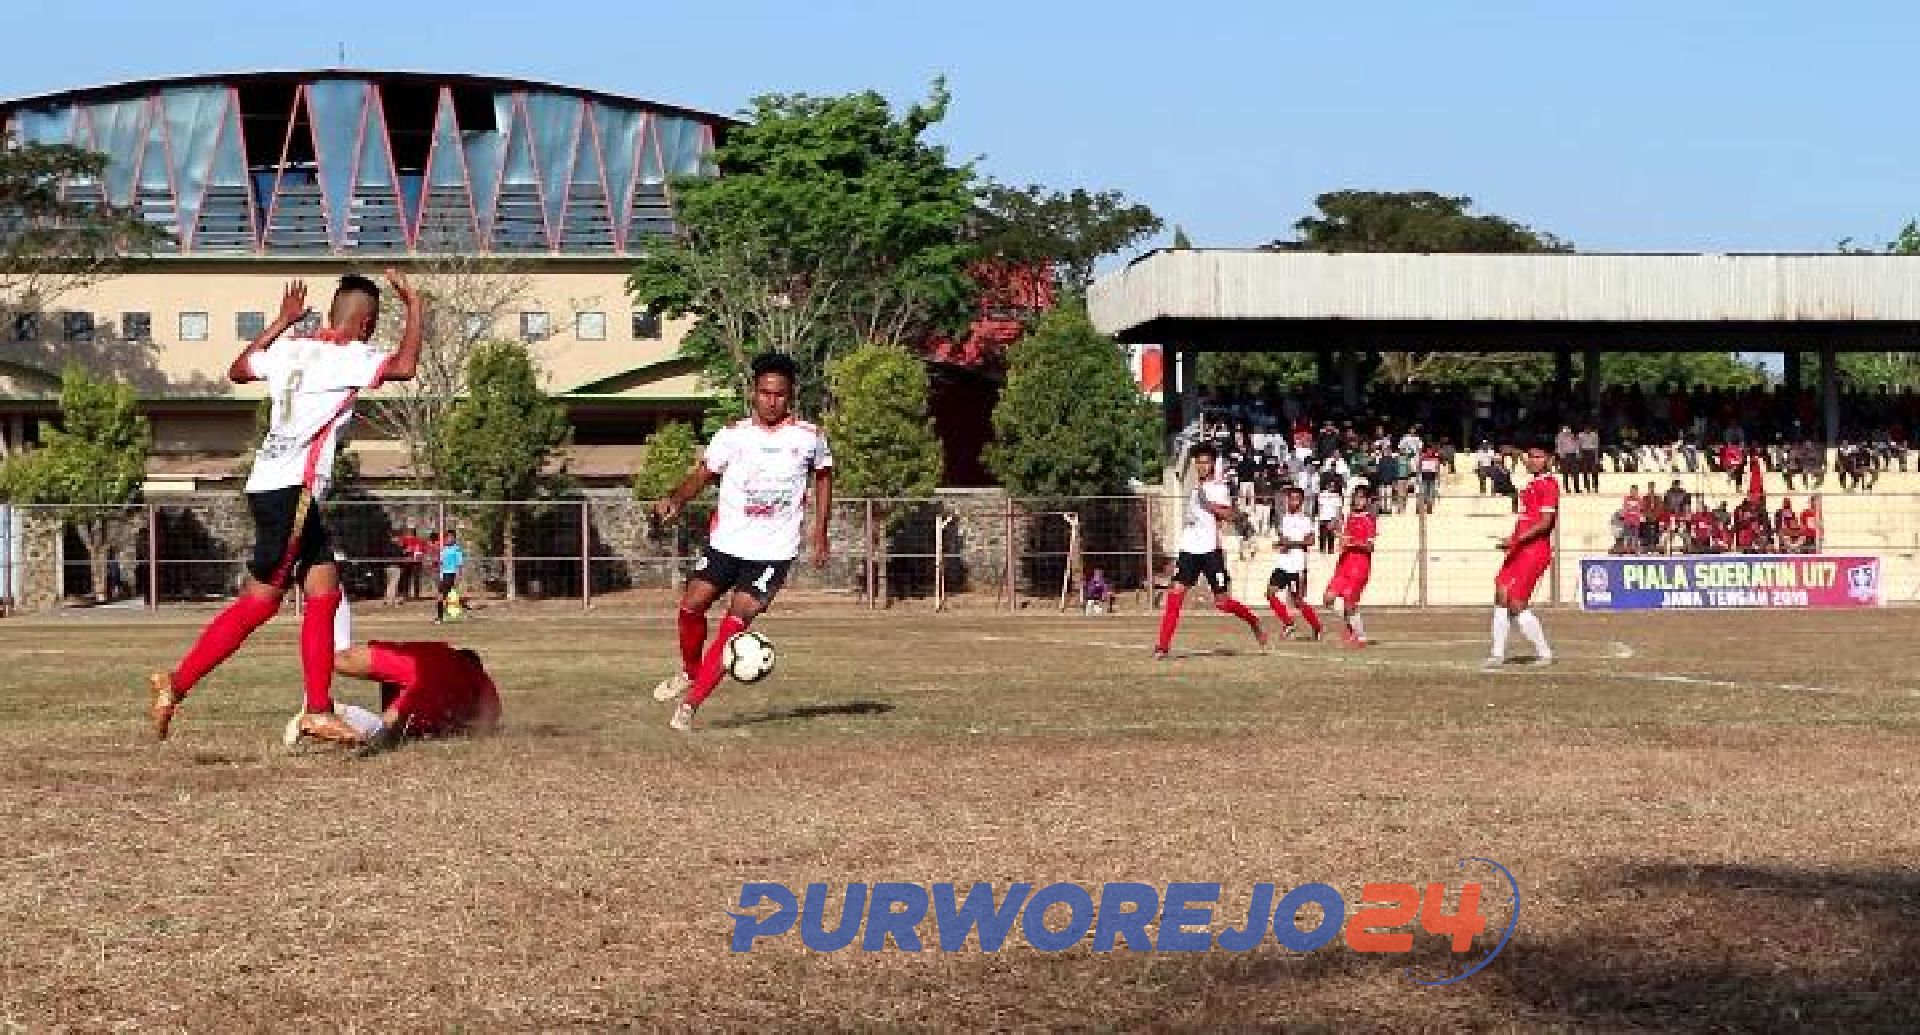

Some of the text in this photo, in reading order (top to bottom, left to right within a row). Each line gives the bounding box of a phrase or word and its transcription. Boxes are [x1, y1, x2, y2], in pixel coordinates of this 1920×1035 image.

[1623, 564, 1689, 589] PIALA
[1803, 562, 1837, 587] U17
[1662, 591, 1702, 606] JAWA
